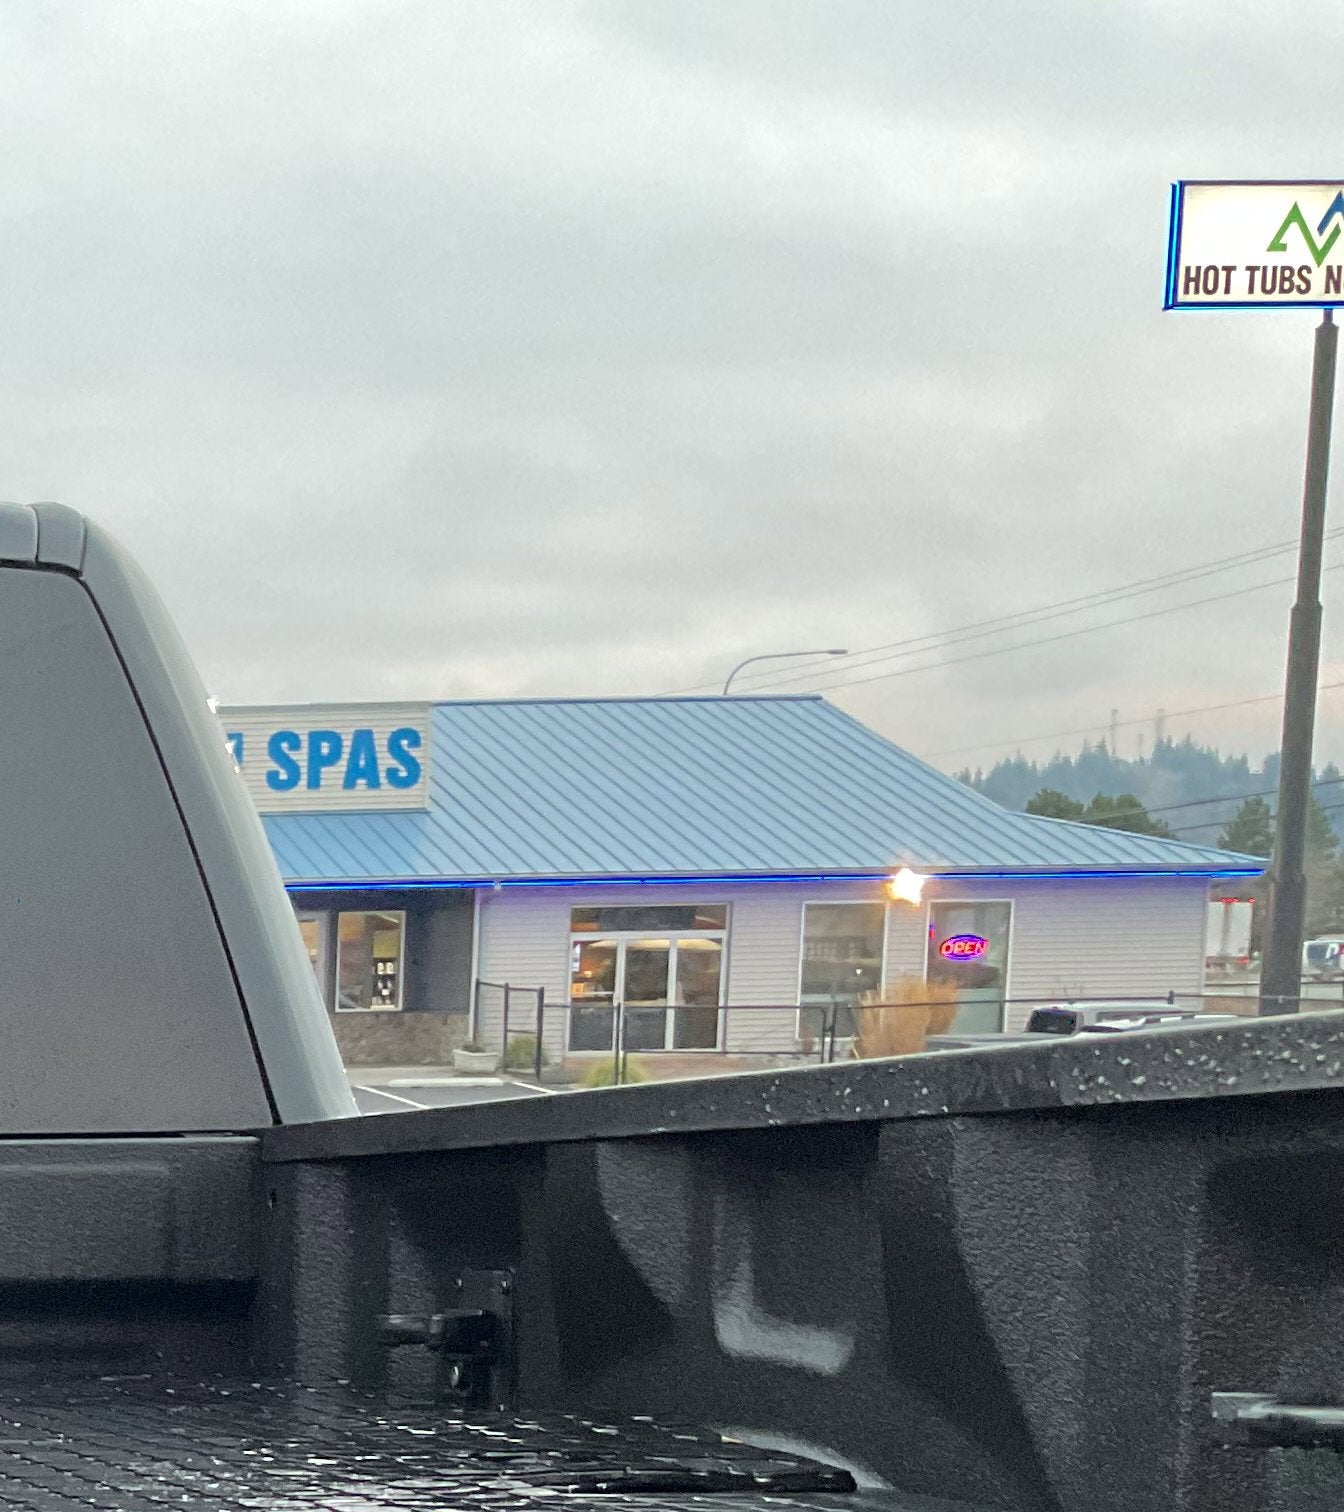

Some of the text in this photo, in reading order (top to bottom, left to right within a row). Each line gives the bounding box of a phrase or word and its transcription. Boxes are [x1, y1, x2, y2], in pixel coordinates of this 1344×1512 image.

[1183, 264, 1344, 295] HOT TUBS N
[266, 728, 422, 792] SPAS
[941, 940, 988, 955] OPEN
